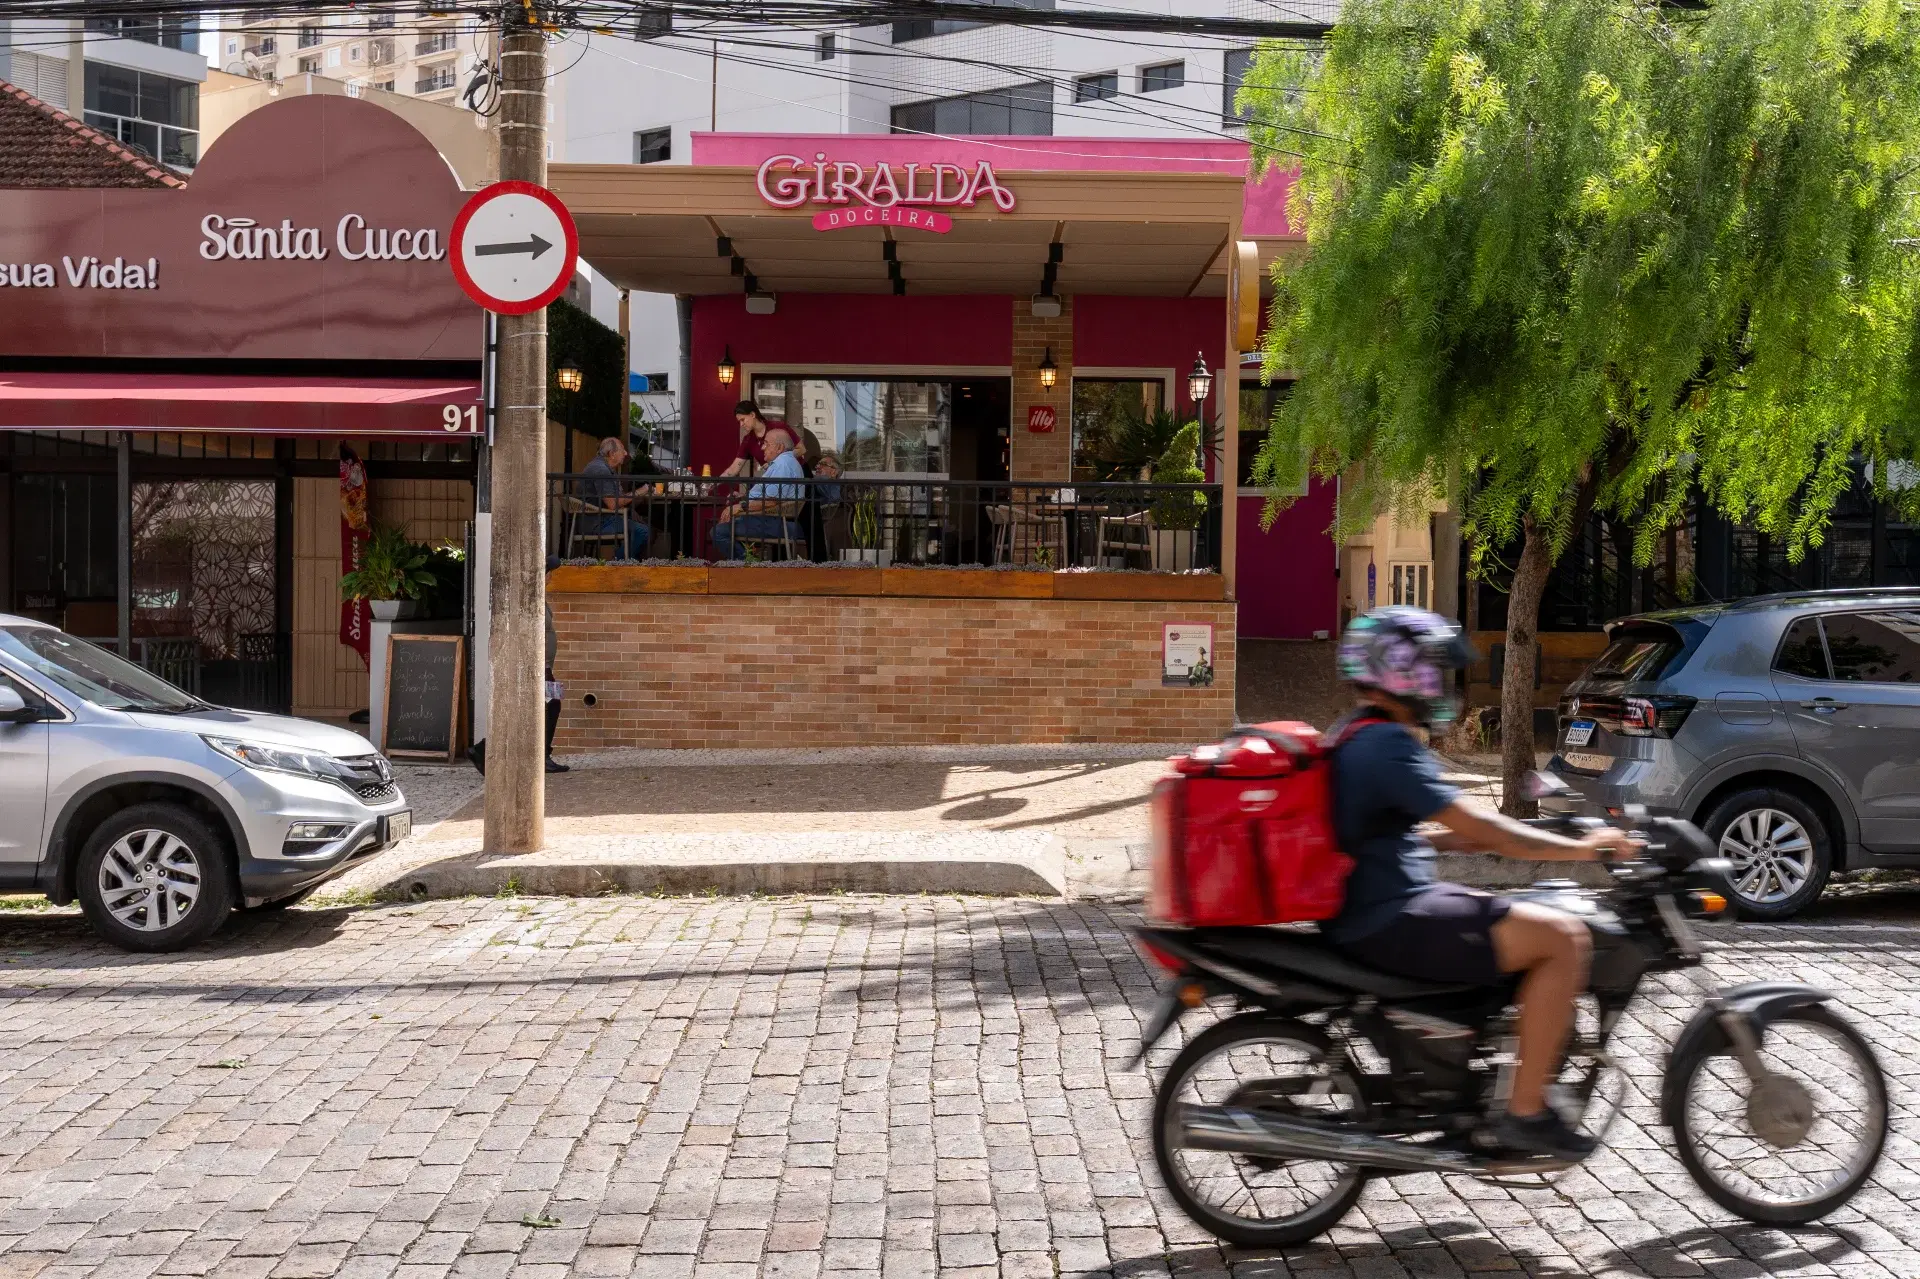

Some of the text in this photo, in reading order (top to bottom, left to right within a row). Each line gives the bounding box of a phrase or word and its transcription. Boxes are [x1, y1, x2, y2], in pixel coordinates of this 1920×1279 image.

[829, 208, 936, 227] DOCEIRA
[199, 213, 445, 261] Santa Cuca
[0, 255, 158, 289] sua Vida!
[443, 404, 478, 433] 91
[1030, 409, 1054, 430] illy
